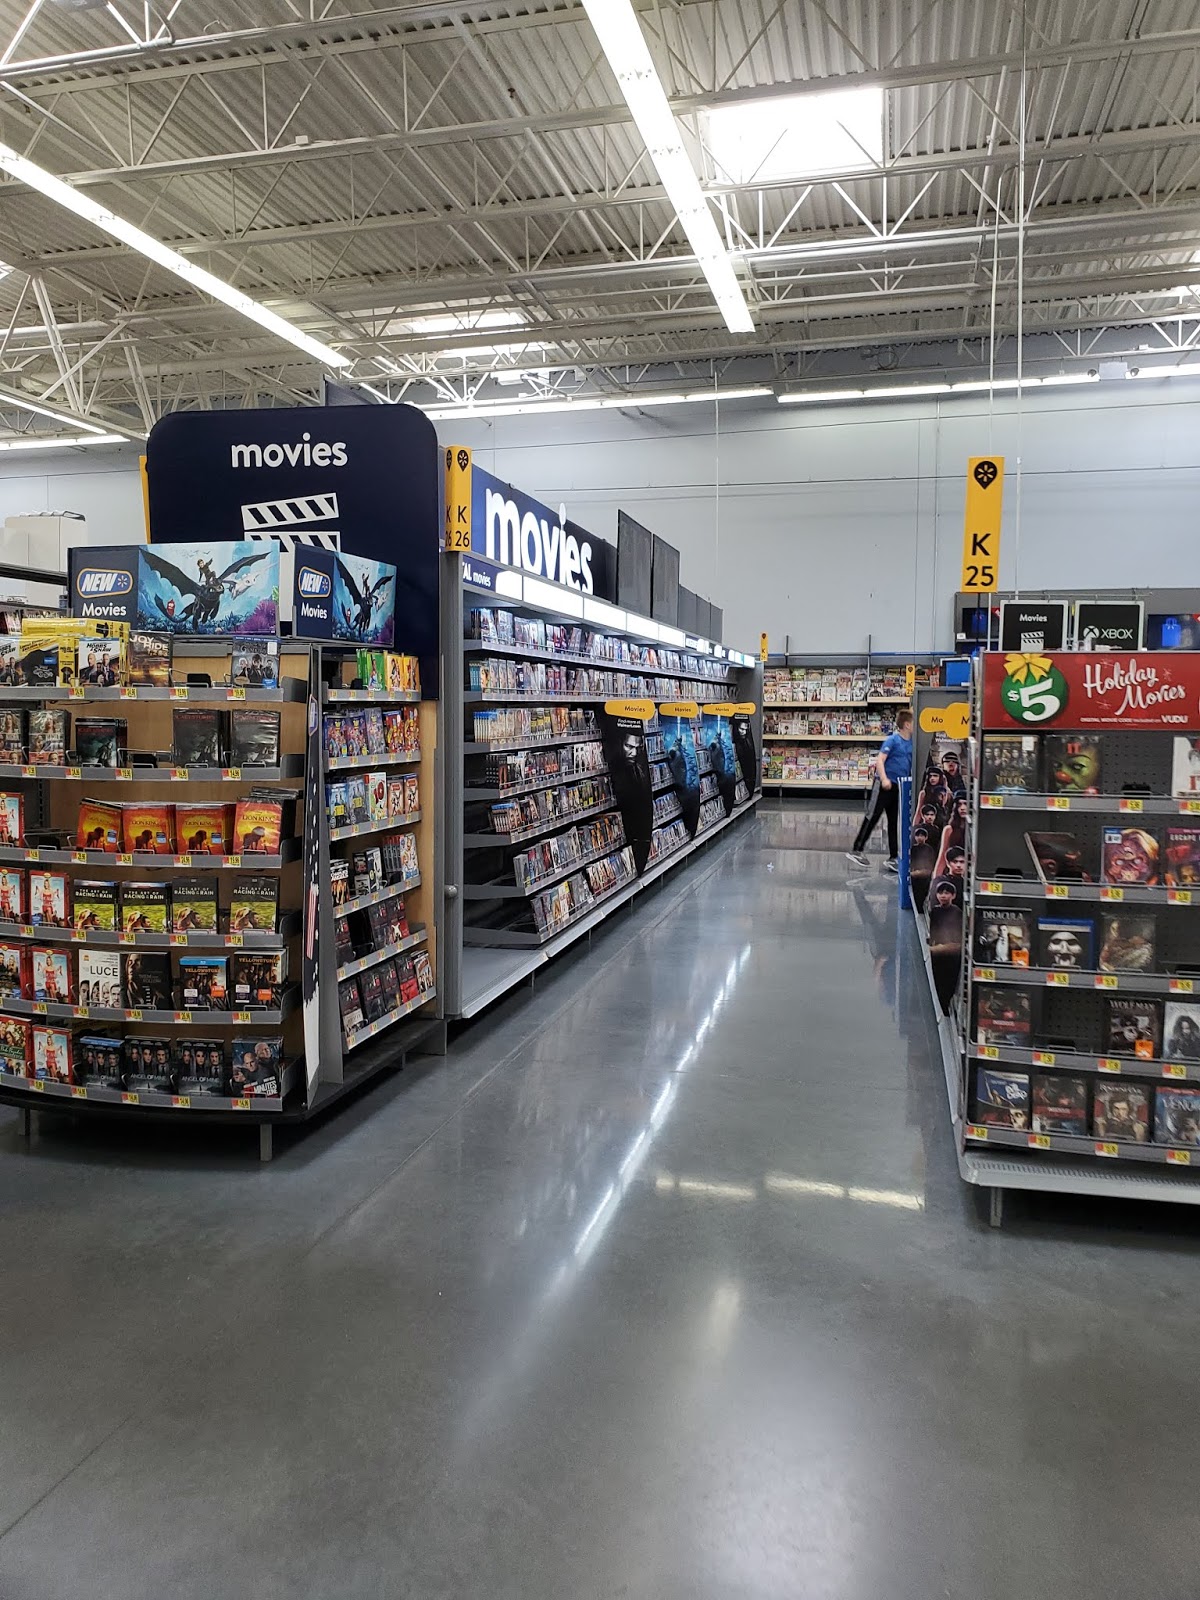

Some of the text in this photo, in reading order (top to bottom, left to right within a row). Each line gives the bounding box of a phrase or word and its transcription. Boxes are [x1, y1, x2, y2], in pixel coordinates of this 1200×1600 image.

[231, 433, 348, 468] movies
[457, 505, 467, 523] K
[455, 530, 470, 547] 26
[485, 488, 594, 595] movies
[971, 533, 991, 556] K
[81, 572, 117, 594] NEW
[301, 569, 323, 594] NEW
[473, 572, 491, 587] movies
[965, 565, 994, 587] 25
[82, 602, 127, 618] Movies
[301, 601, 328, 620] Movies
[1019, 613, 1048, 624] Movies
[129, 635, 154, 644] JOY
[1101, 627, 1134, 640] XBOX
[143, 642, 169, 651] RIDE
[1083, 658, 1160, 698] Holiday
[1007, 677, 1060, 722] $5
[1114, 684, 1186, 716] Movies
[624, 705, 646, 713] Movies
[1161, 714, 1189, 724] VUDU
[242, 814, 258, 822] LION
[983, 910, 1024, 920] DRACULA
[90, 965, 118, 977] LUCE
